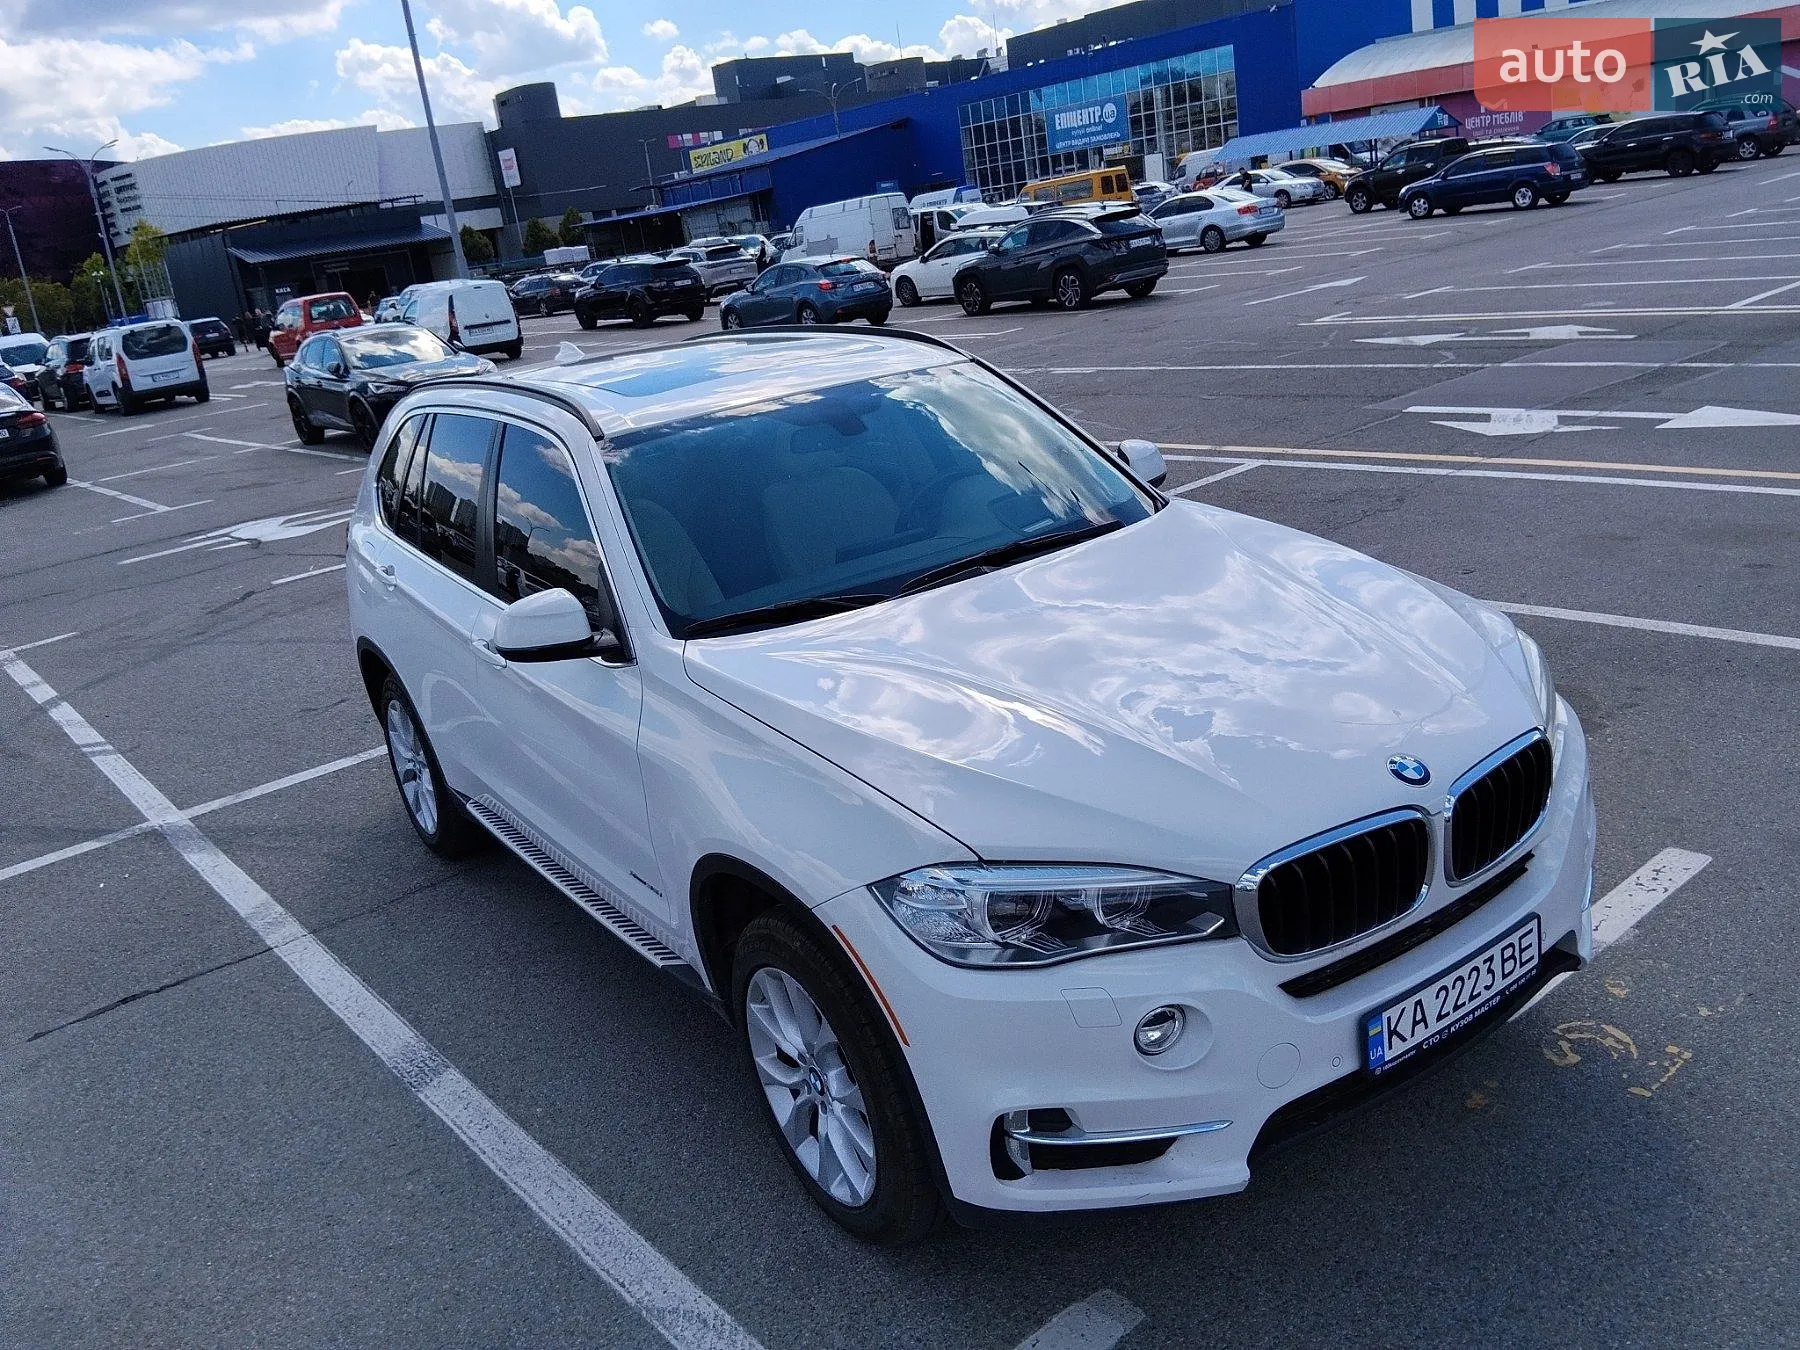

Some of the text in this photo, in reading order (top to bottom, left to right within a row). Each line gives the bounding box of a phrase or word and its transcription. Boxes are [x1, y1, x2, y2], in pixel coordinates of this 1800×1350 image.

[1465, 111, 1524, 130] ЦЕНТР МЕБЛІВ
[1386, 998, 1429, 1051] KA
[1435, 953, 1496, 1024] 2223
[1500, 927, 1534, 981] BE
[1422, 995, 1501, 1049] СТО КУЗОВ МАСТЕР
[1370, 1046, 1384, 1060] UA
